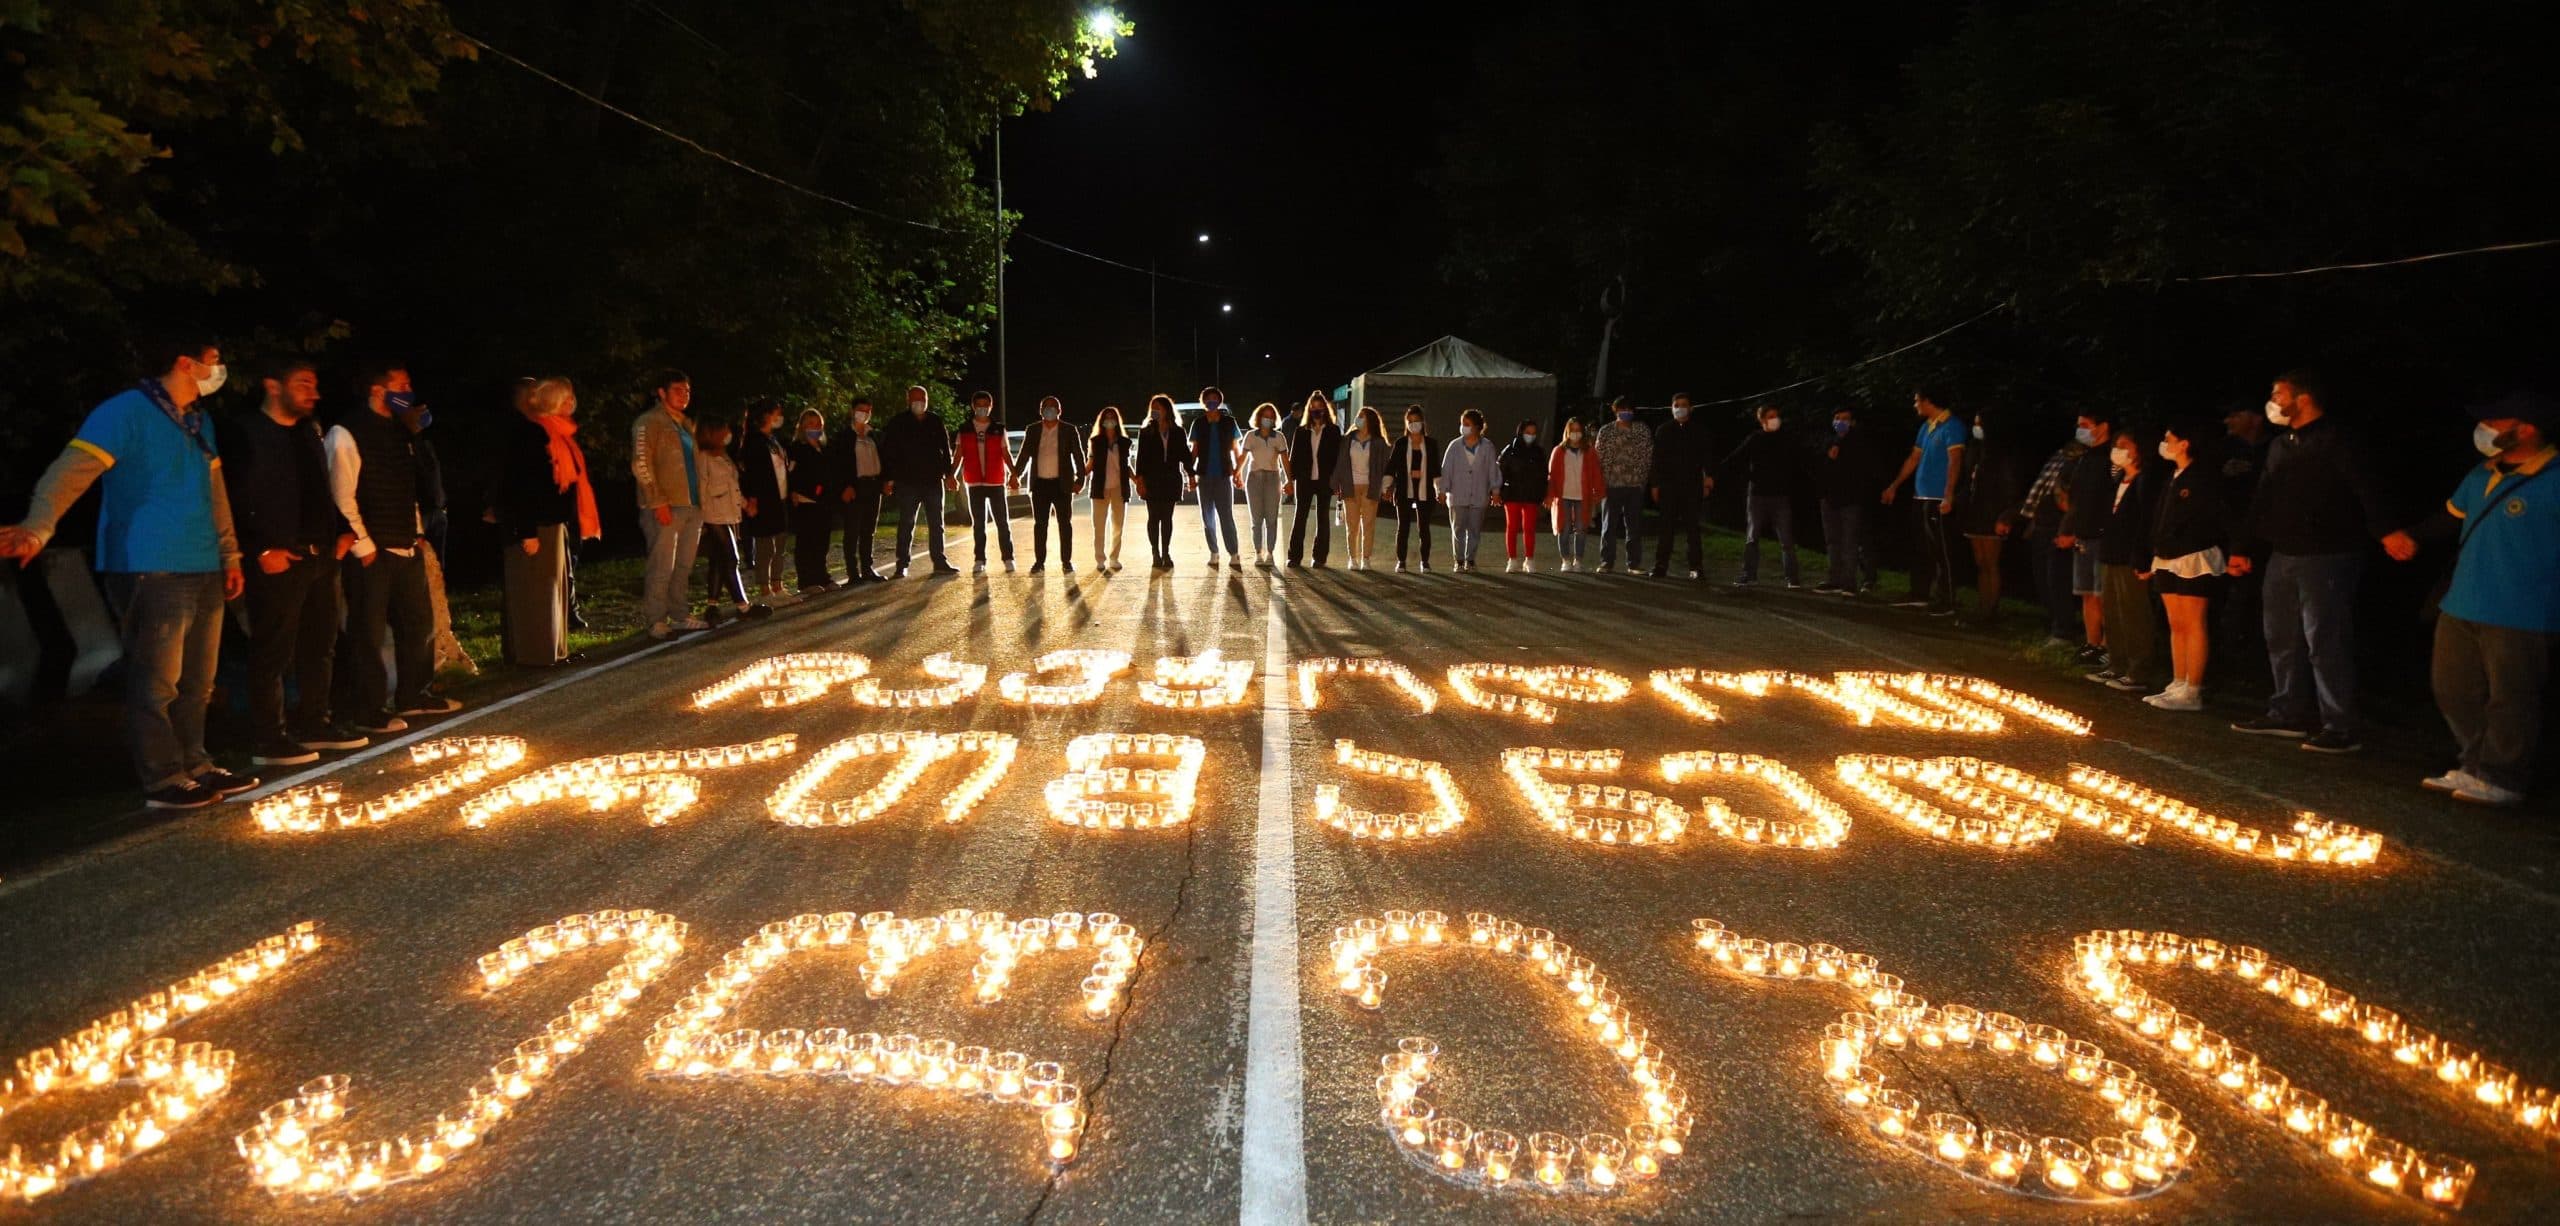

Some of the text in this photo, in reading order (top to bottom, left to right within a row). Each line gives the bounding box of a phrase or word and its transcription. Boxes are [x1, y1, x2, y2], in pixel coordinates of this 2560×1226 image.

[691, 648, 2093, 737] ჩავჭიდოთ
[249, 732, 2384, 866] ერთმანეთს
[0, 907, 2560, 1209] ხელები
